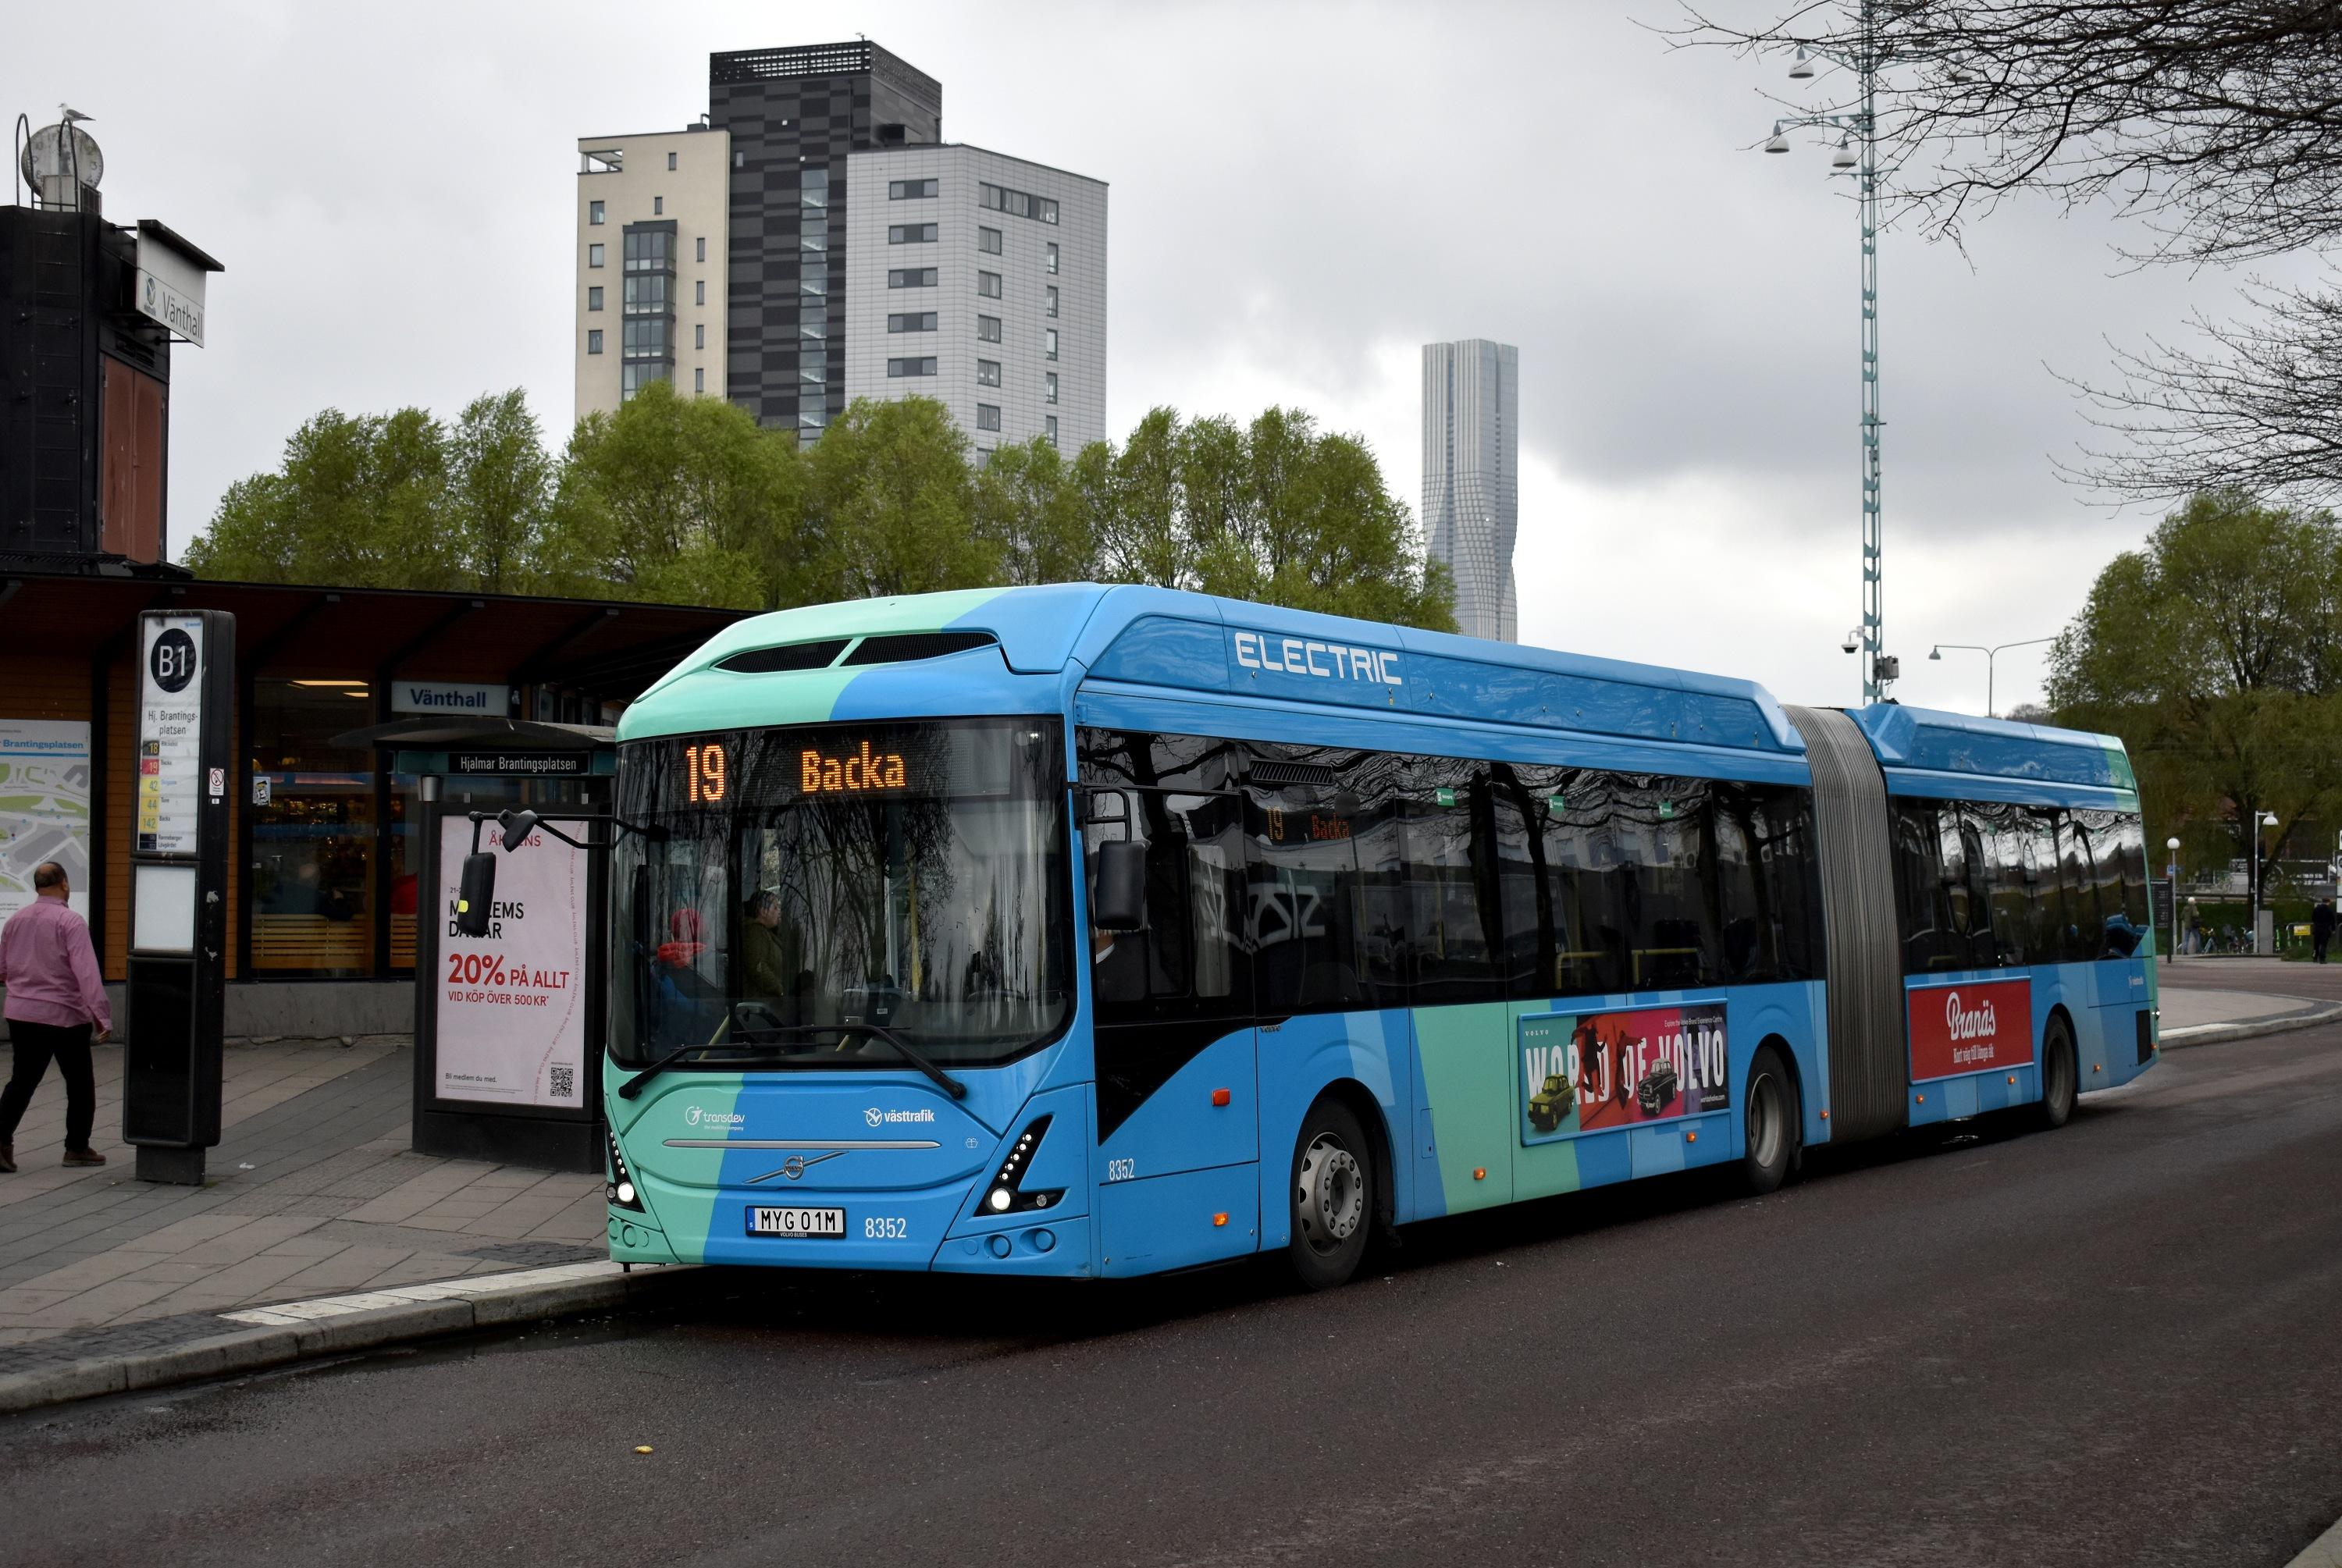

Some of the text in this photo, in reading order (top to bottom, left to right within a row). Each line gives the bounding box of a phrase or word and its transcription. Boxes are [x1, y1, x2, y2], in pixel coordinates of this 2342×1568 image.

[162, 291, 203, 340] Vänthall
[158, 645, 187, 677] B1
[1234, 632, 1402, 685] ELECTRIC
[411, 688, 486, 708] Vänthall
[148, 709, 198, 724] Hj. Brantings-
[158, 724, 187, 737] platsen
[3, 739, 84, 749] Brantingsplatsen
[149, 741, 158, 754] 18
[149, 761, 158, 773] 19
[461, 756, 577, 772] Hjalmar Brantingsplatsen
[686, 741, 906, 802] 19 Backa
[149, 780, 158, 791] 42
[147, 799, 157, 810] 44
[143, 817, 156, 829] 142
[1266, 805, 1350, 840] 19 Backa
[489, 830, 541, 847] ÅNS
[449, 900, 525, 919] MEMS
[448, 953, 570, 989] 20% PÅ ALLT
[448, 990, 464, 1001] VID
[466, 989, 485, 1003] KÖP
[487, 990, 511, 1004] ÖVER
[514, 994, 532, 1005] 500
[1946, 991, 1995, 1041] Branäs
[703, 1109, 934, 1123] transdev västtrafik
[1109, 1157, 1135, 1181] 8352
[761, 1210, 795, 1231] MYG
[801, 1211, 837, 1232] 01M
[865, 1217, 907, 1239] 8352
